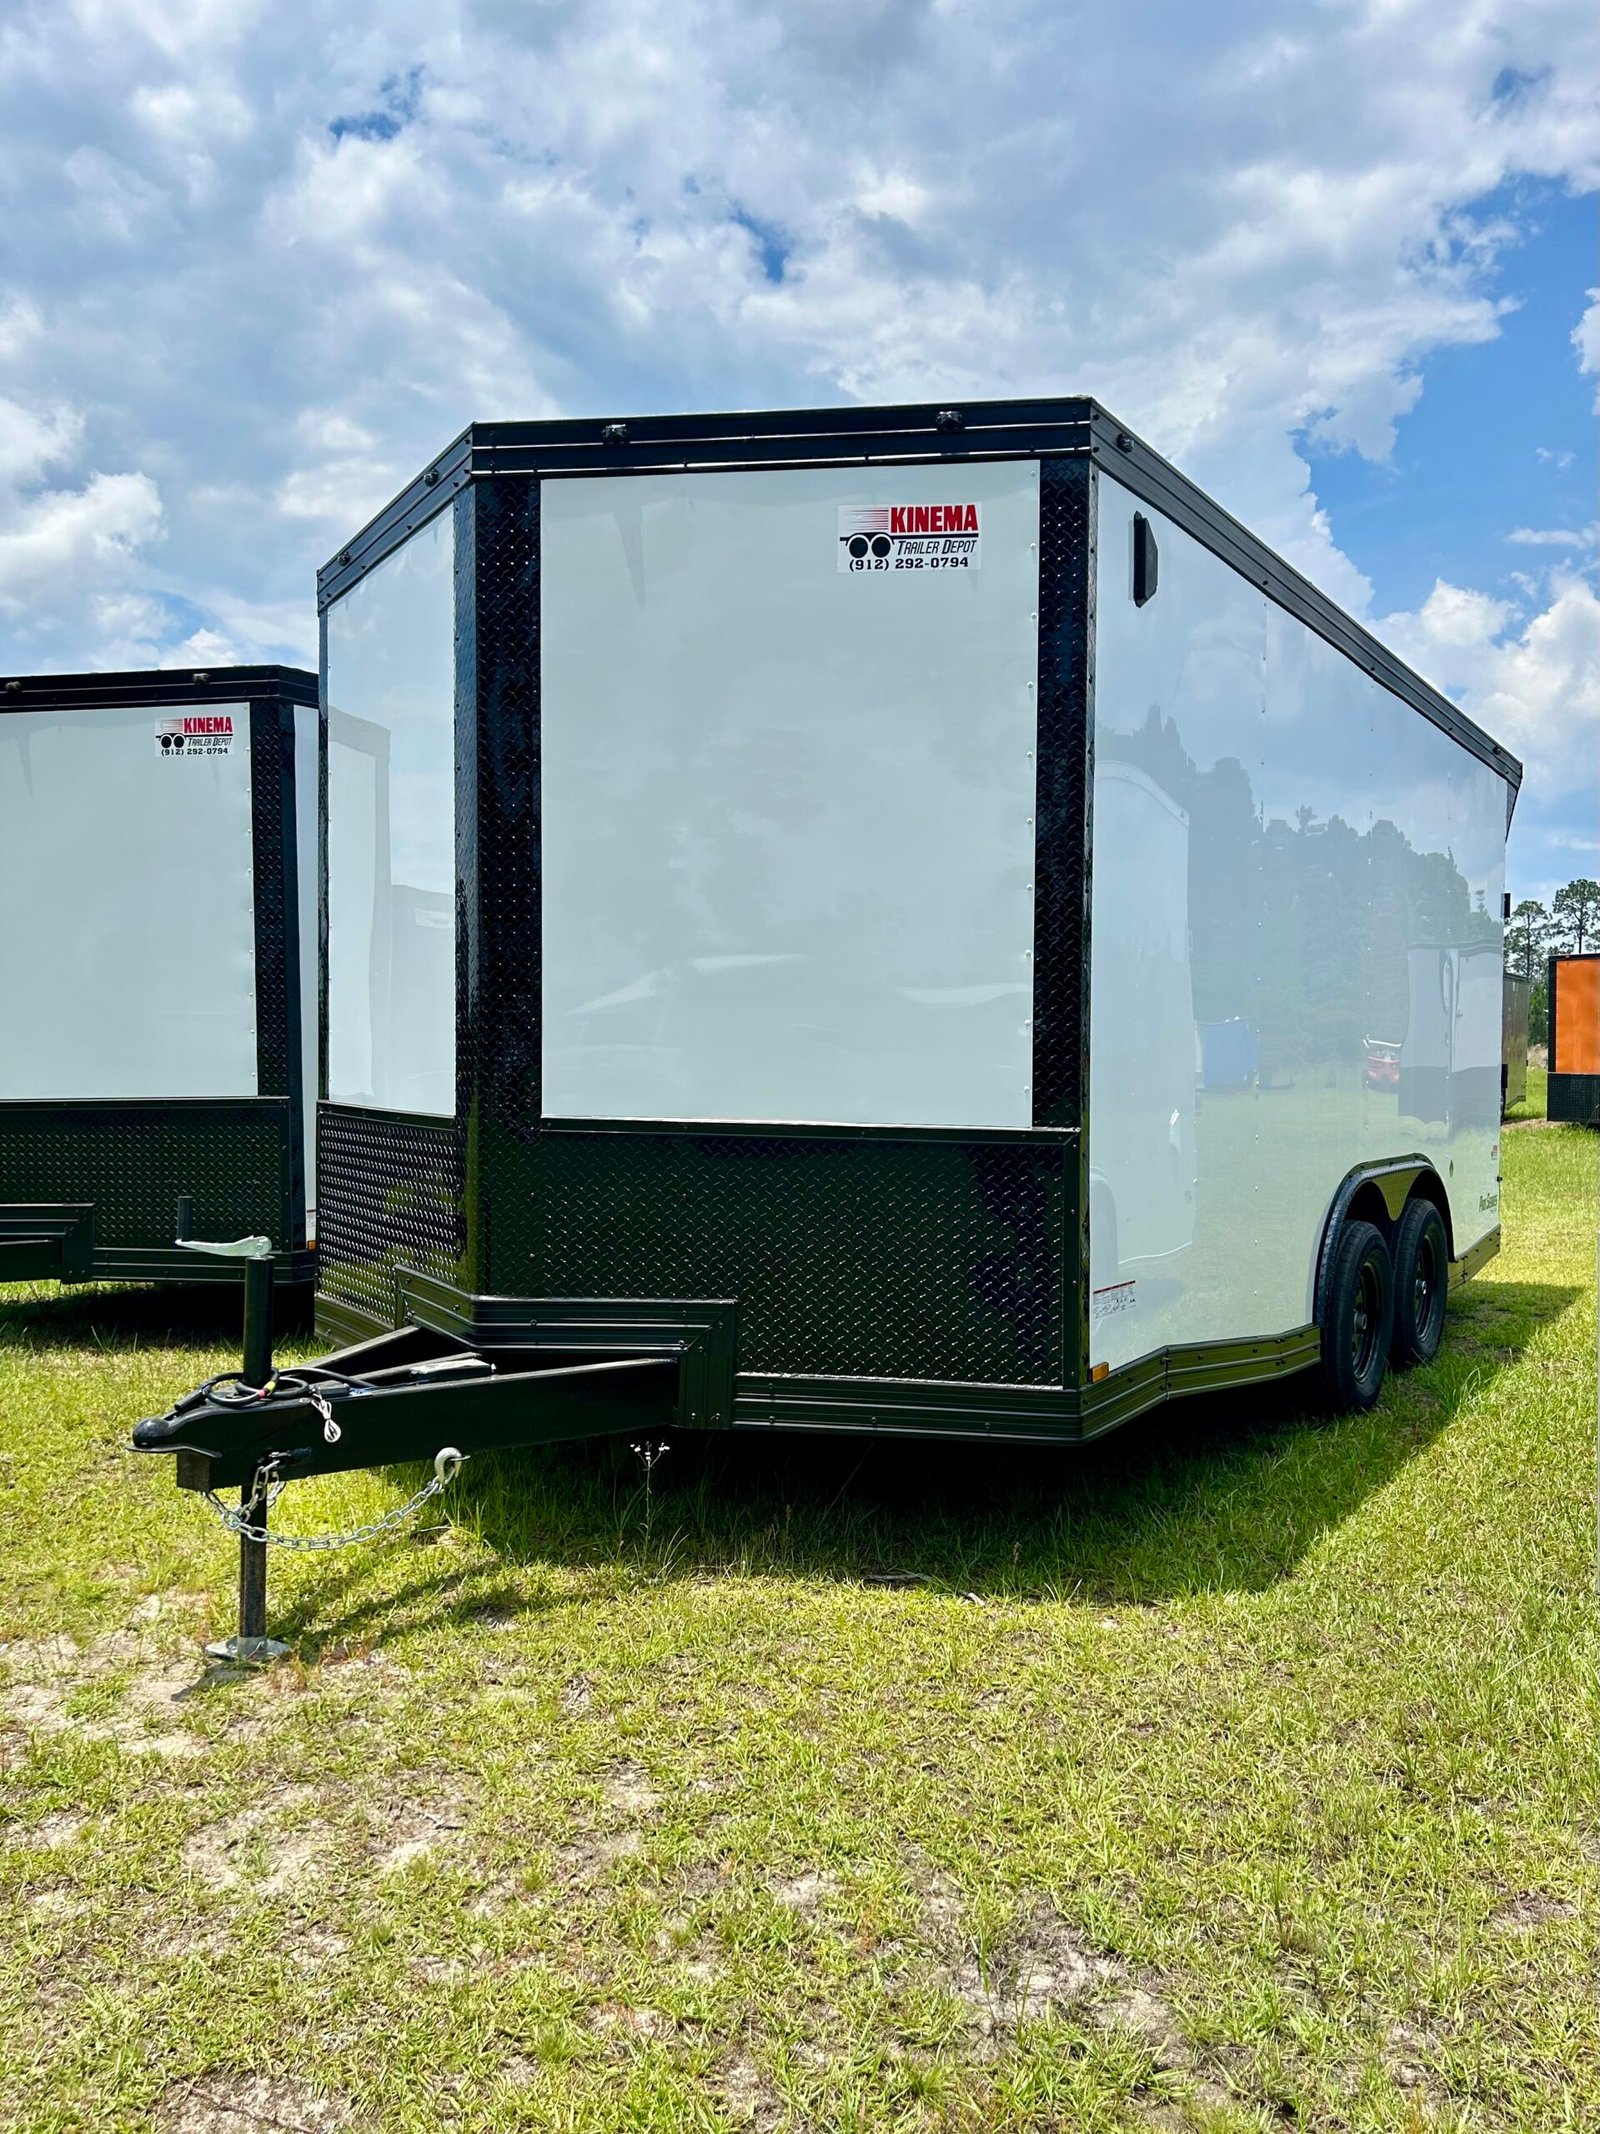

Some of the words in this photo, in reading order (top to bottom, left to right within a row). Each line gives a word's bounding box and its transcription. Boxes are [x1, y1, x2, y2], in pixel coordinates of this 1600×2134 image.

[891, 504, 979, 533] KINEMA
[897, 540, 940, 556] TRAILER
[942, 539, 977, 555] DEPOT
[849, 558, 890, 572] (912)
[895, 557, 969, 569] 292-0794
[183, 716, 233, 734] KINEMA
[188, 737, 212, 747] TRAILER
[212, 736, 232, 747] DEPOT
[161, 748, 185, 757] (912)
[187, 747, 228, 755] 292-0794
